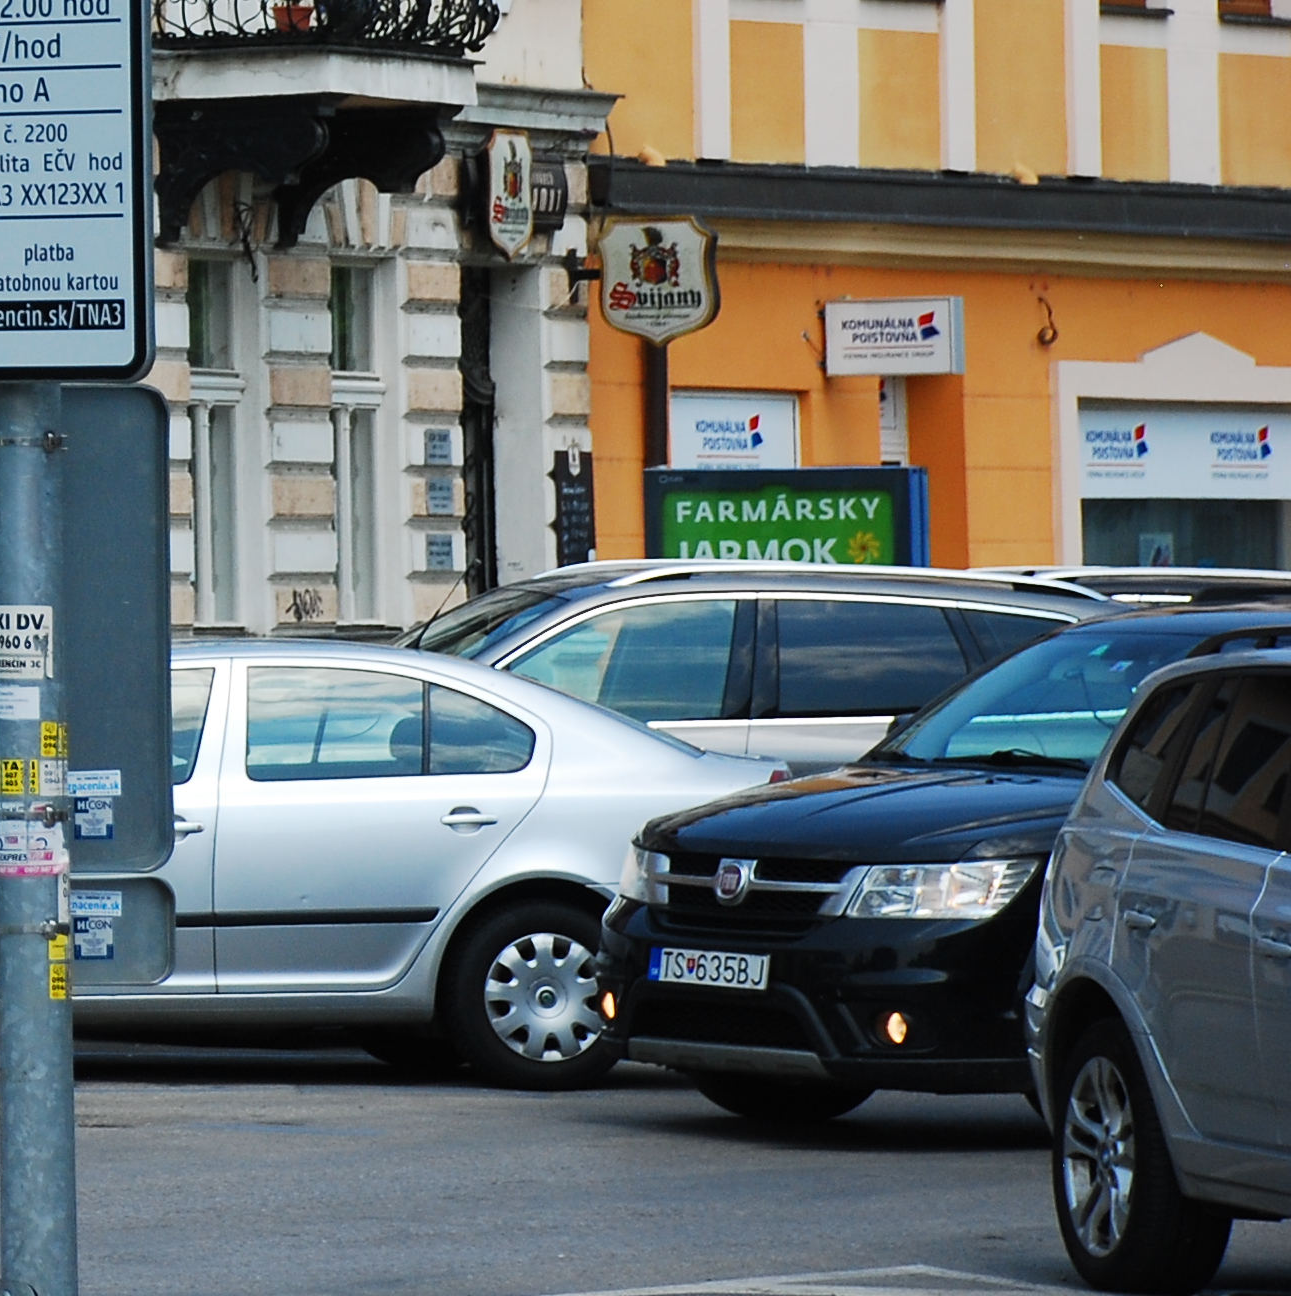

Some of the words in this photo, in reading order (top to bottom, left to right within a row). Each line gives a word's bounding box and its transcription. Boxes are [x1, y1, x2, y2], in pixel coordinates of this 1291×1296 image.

[33, 76, 51, 102] A
[3, 124, 18, 143] č.
[24, 123, 68, 143] 2200
[43, 148, 76, 172] EČV
[88, 152, 123, 171] hod
[20, 183, 108, 207] XX123XX
[117, 181, 124, 204] 1
[24, 243, 75, 266] platba
[66, 272, 119, 291] kartou
[609, 281, 702, 311] Svijany
[841, 317, 915, 331] KOMUNÁLNA
[695, 415, 746, 435] KOMUNÁLNA
[676, 493, 881, 524] FARMÁRSKY
[695, 954, 765, 986] 635BJ
